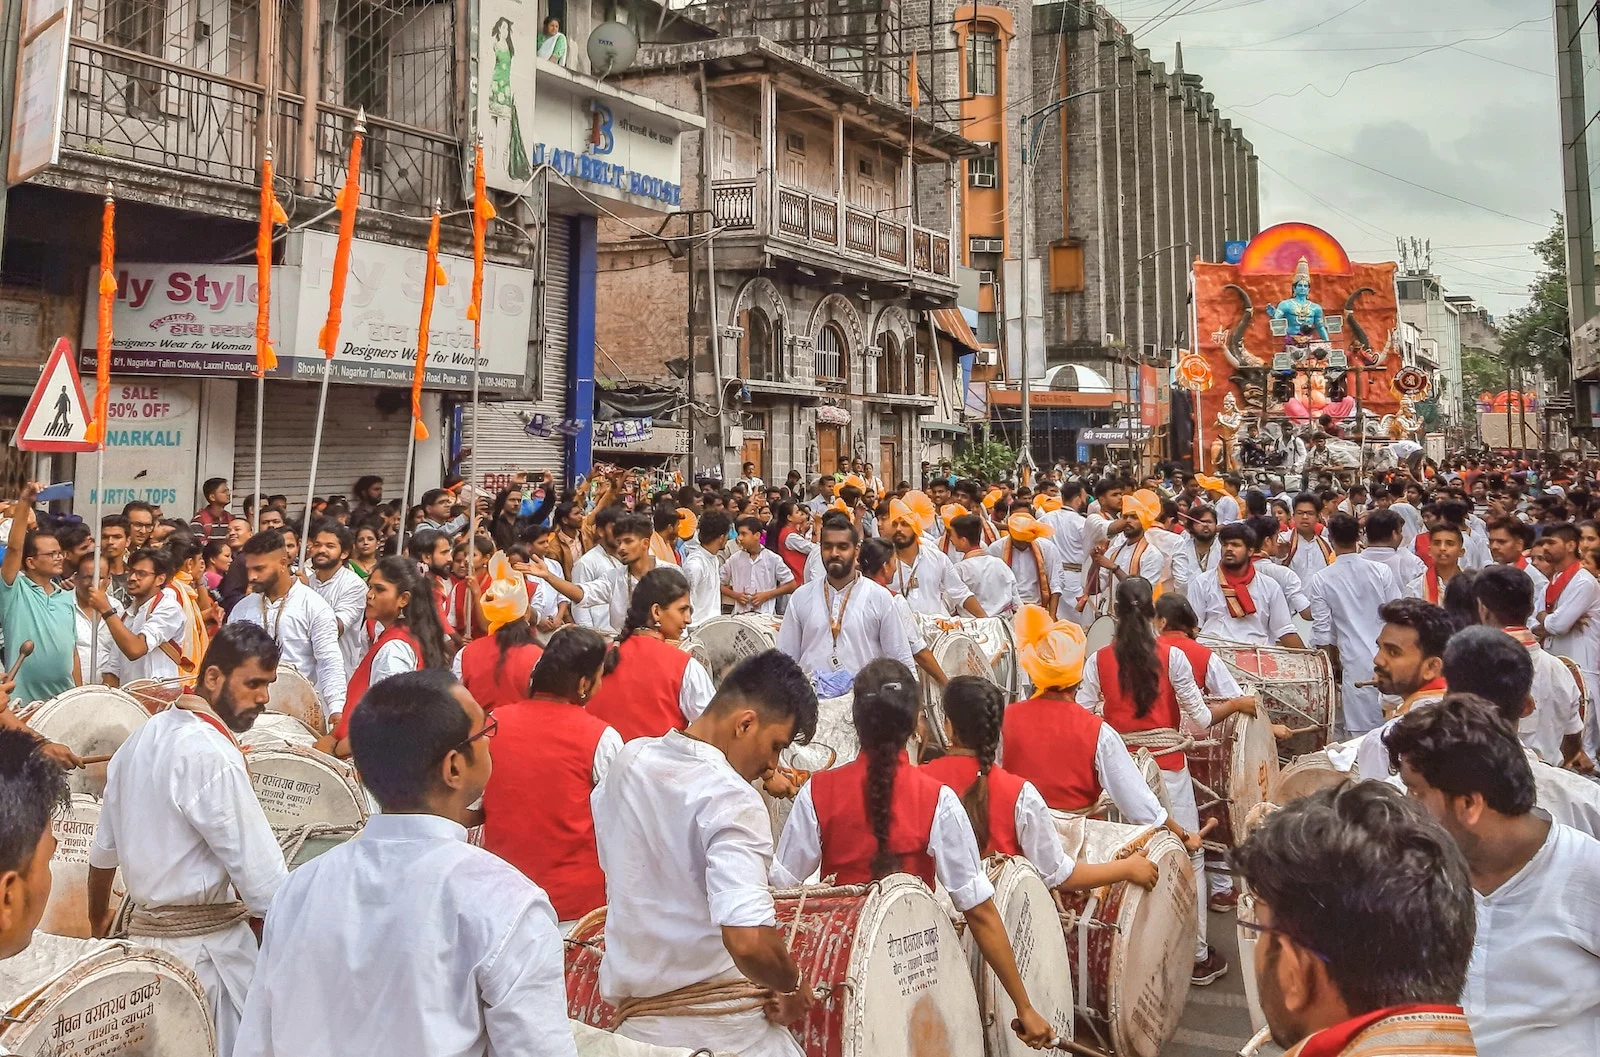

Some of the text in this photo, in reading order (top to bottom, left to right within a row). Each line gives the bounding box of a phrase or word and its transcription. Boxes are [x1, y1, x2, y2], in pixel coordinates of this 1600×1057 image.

[579, 154, 625, 189] BELT
[628, 170, 681, 206] HOUSE
[110, 337, 252, 351] esigners Wear for Woman
[342, 342, 398, 361] Designers
[401, 347, 430, 362] Wer
[432, 350, 449, 364] for
[126, 358, 157, 369] Nagarkar
[158, 359, 176, 368] Talim
[177, 359, 202, 371] Chowk,
[224, 361, 245, 372] Road,
[245, 362, 259, 371] Pun
[297, 361, 316, 377] Shop
[340, 365, 369, 380] Nagarkar
[369, 368, 386, 378] Talim
[386, 368, 407, 381] Chowk,
[426, 372, 442, 384] Road,
[442, 373, 457, 384] Pune
[121, 386, 159, 400] SALE
[108, 402, 170, 418] 50% OFF
[1083, 430, 1094, 440] श्री
[1095, 432, 1124, 440] गजानन
[145, 488, 176, 504] TOPS
[51, 979, 161, 1040] जीवन वसंतराव काकडे
[121, 1002, 154, 1026] व्यापारी
